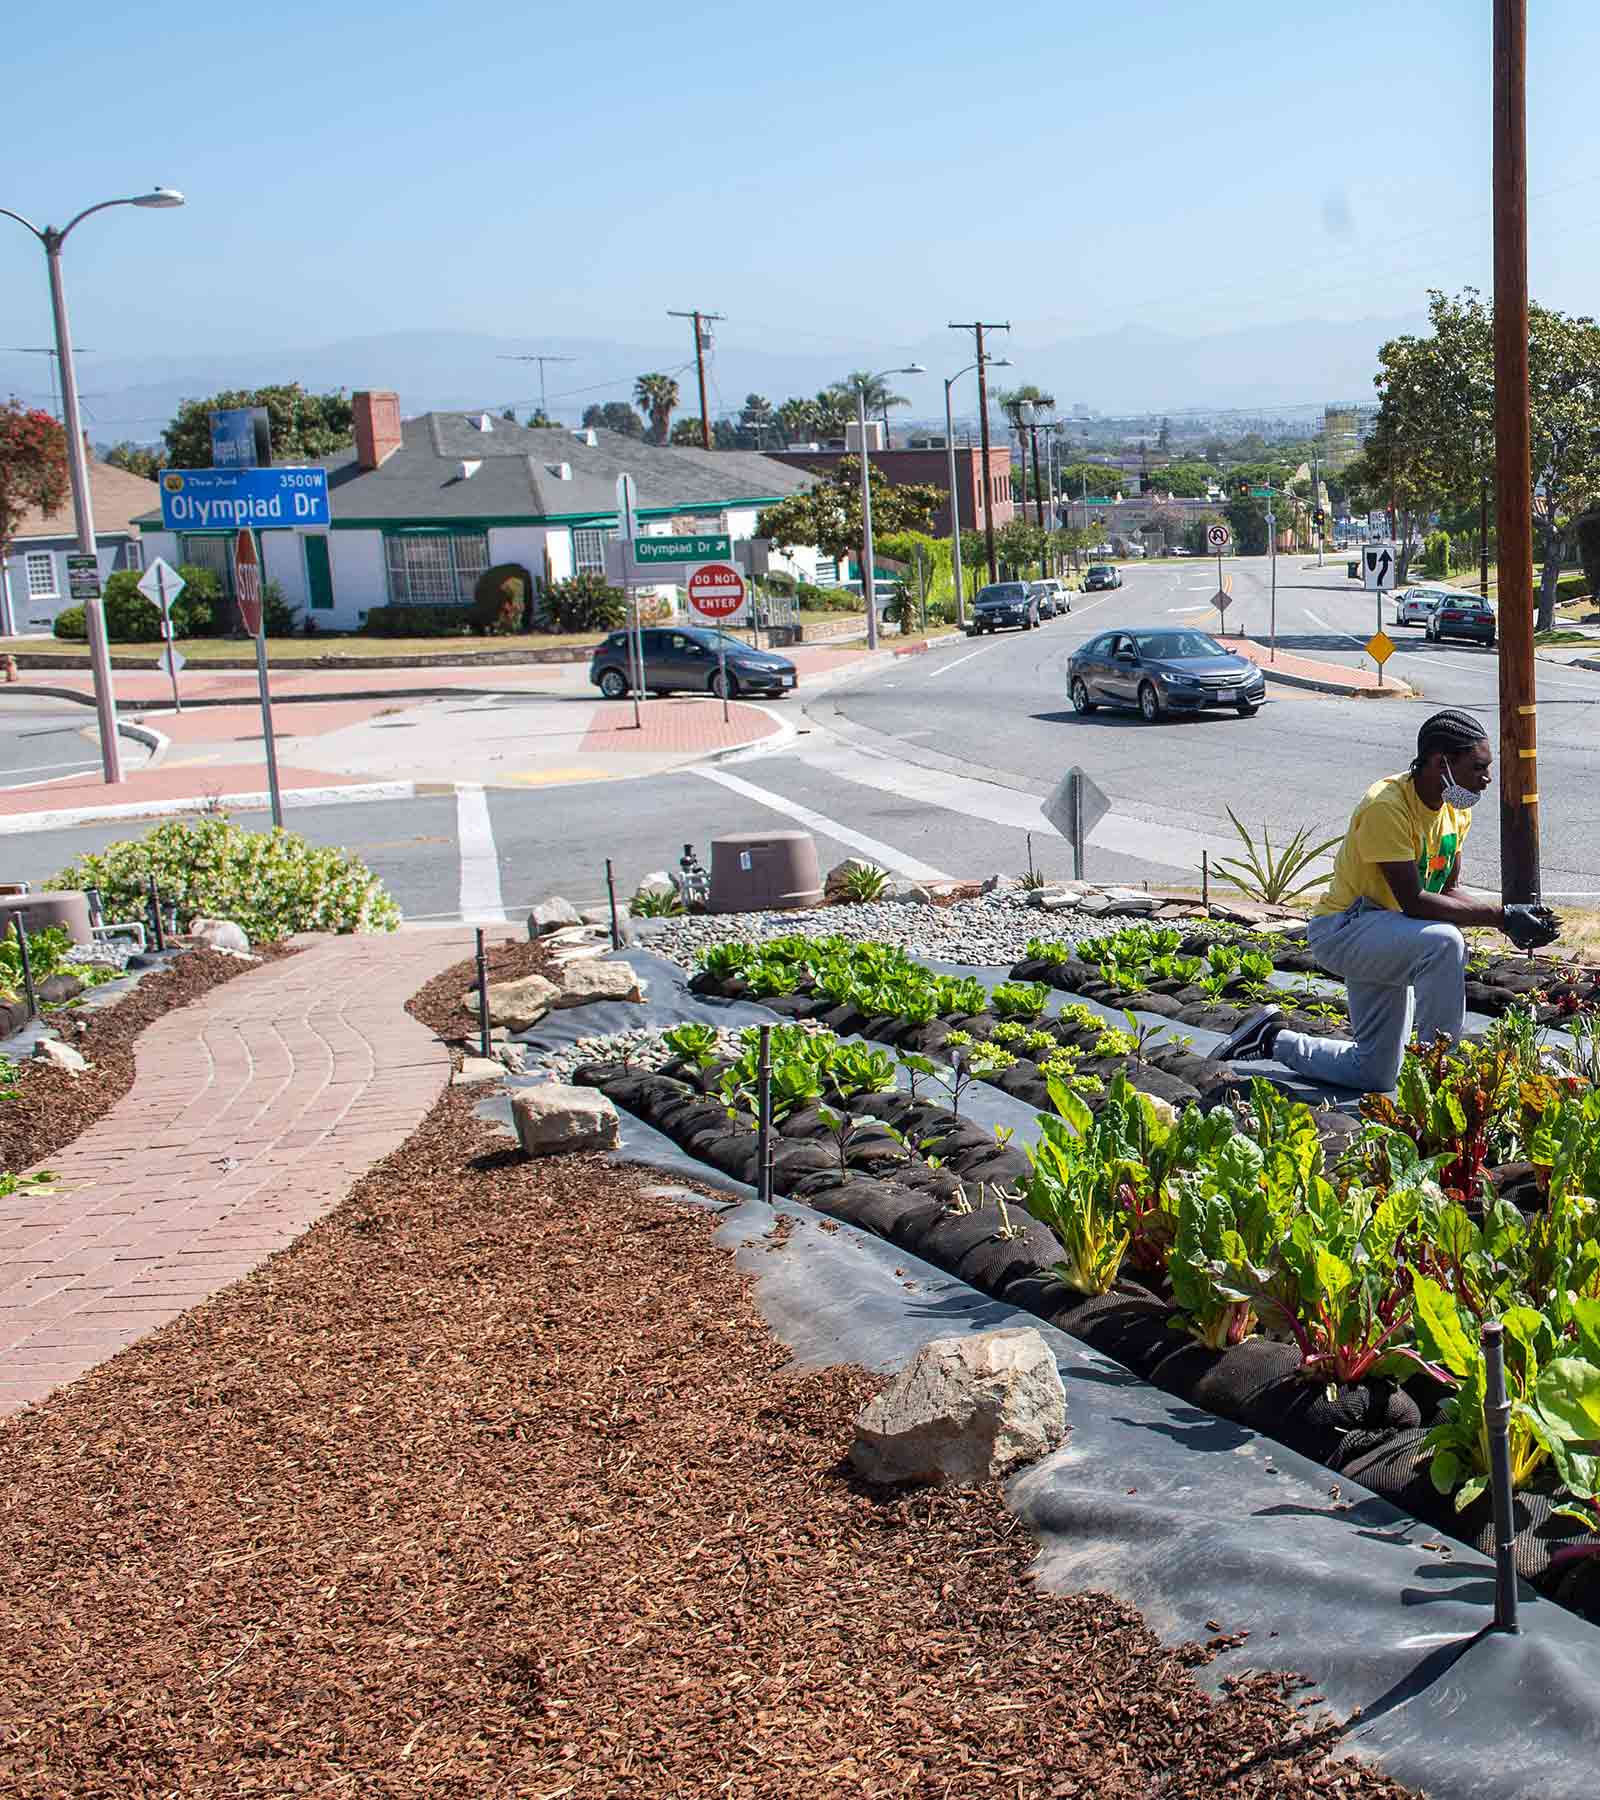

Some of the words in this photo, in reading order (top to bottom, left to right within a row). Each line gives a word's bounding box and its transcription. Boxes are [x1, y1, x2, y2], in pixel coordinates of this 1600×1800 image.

[280, 474, 322, 488] 3500W
[171, 494, 281, 525] Olympiad
[294, 493, 320, 516] Dr
[640, 543, 692, 557] Olympiad
[698, 542, 710, 553] Dr
[239, 563, 258, 602] STOP
[695, 575, 709, 585] DO
[715, 574, 736, 584] NOT
[699, 598, 736, 609] ENTER
